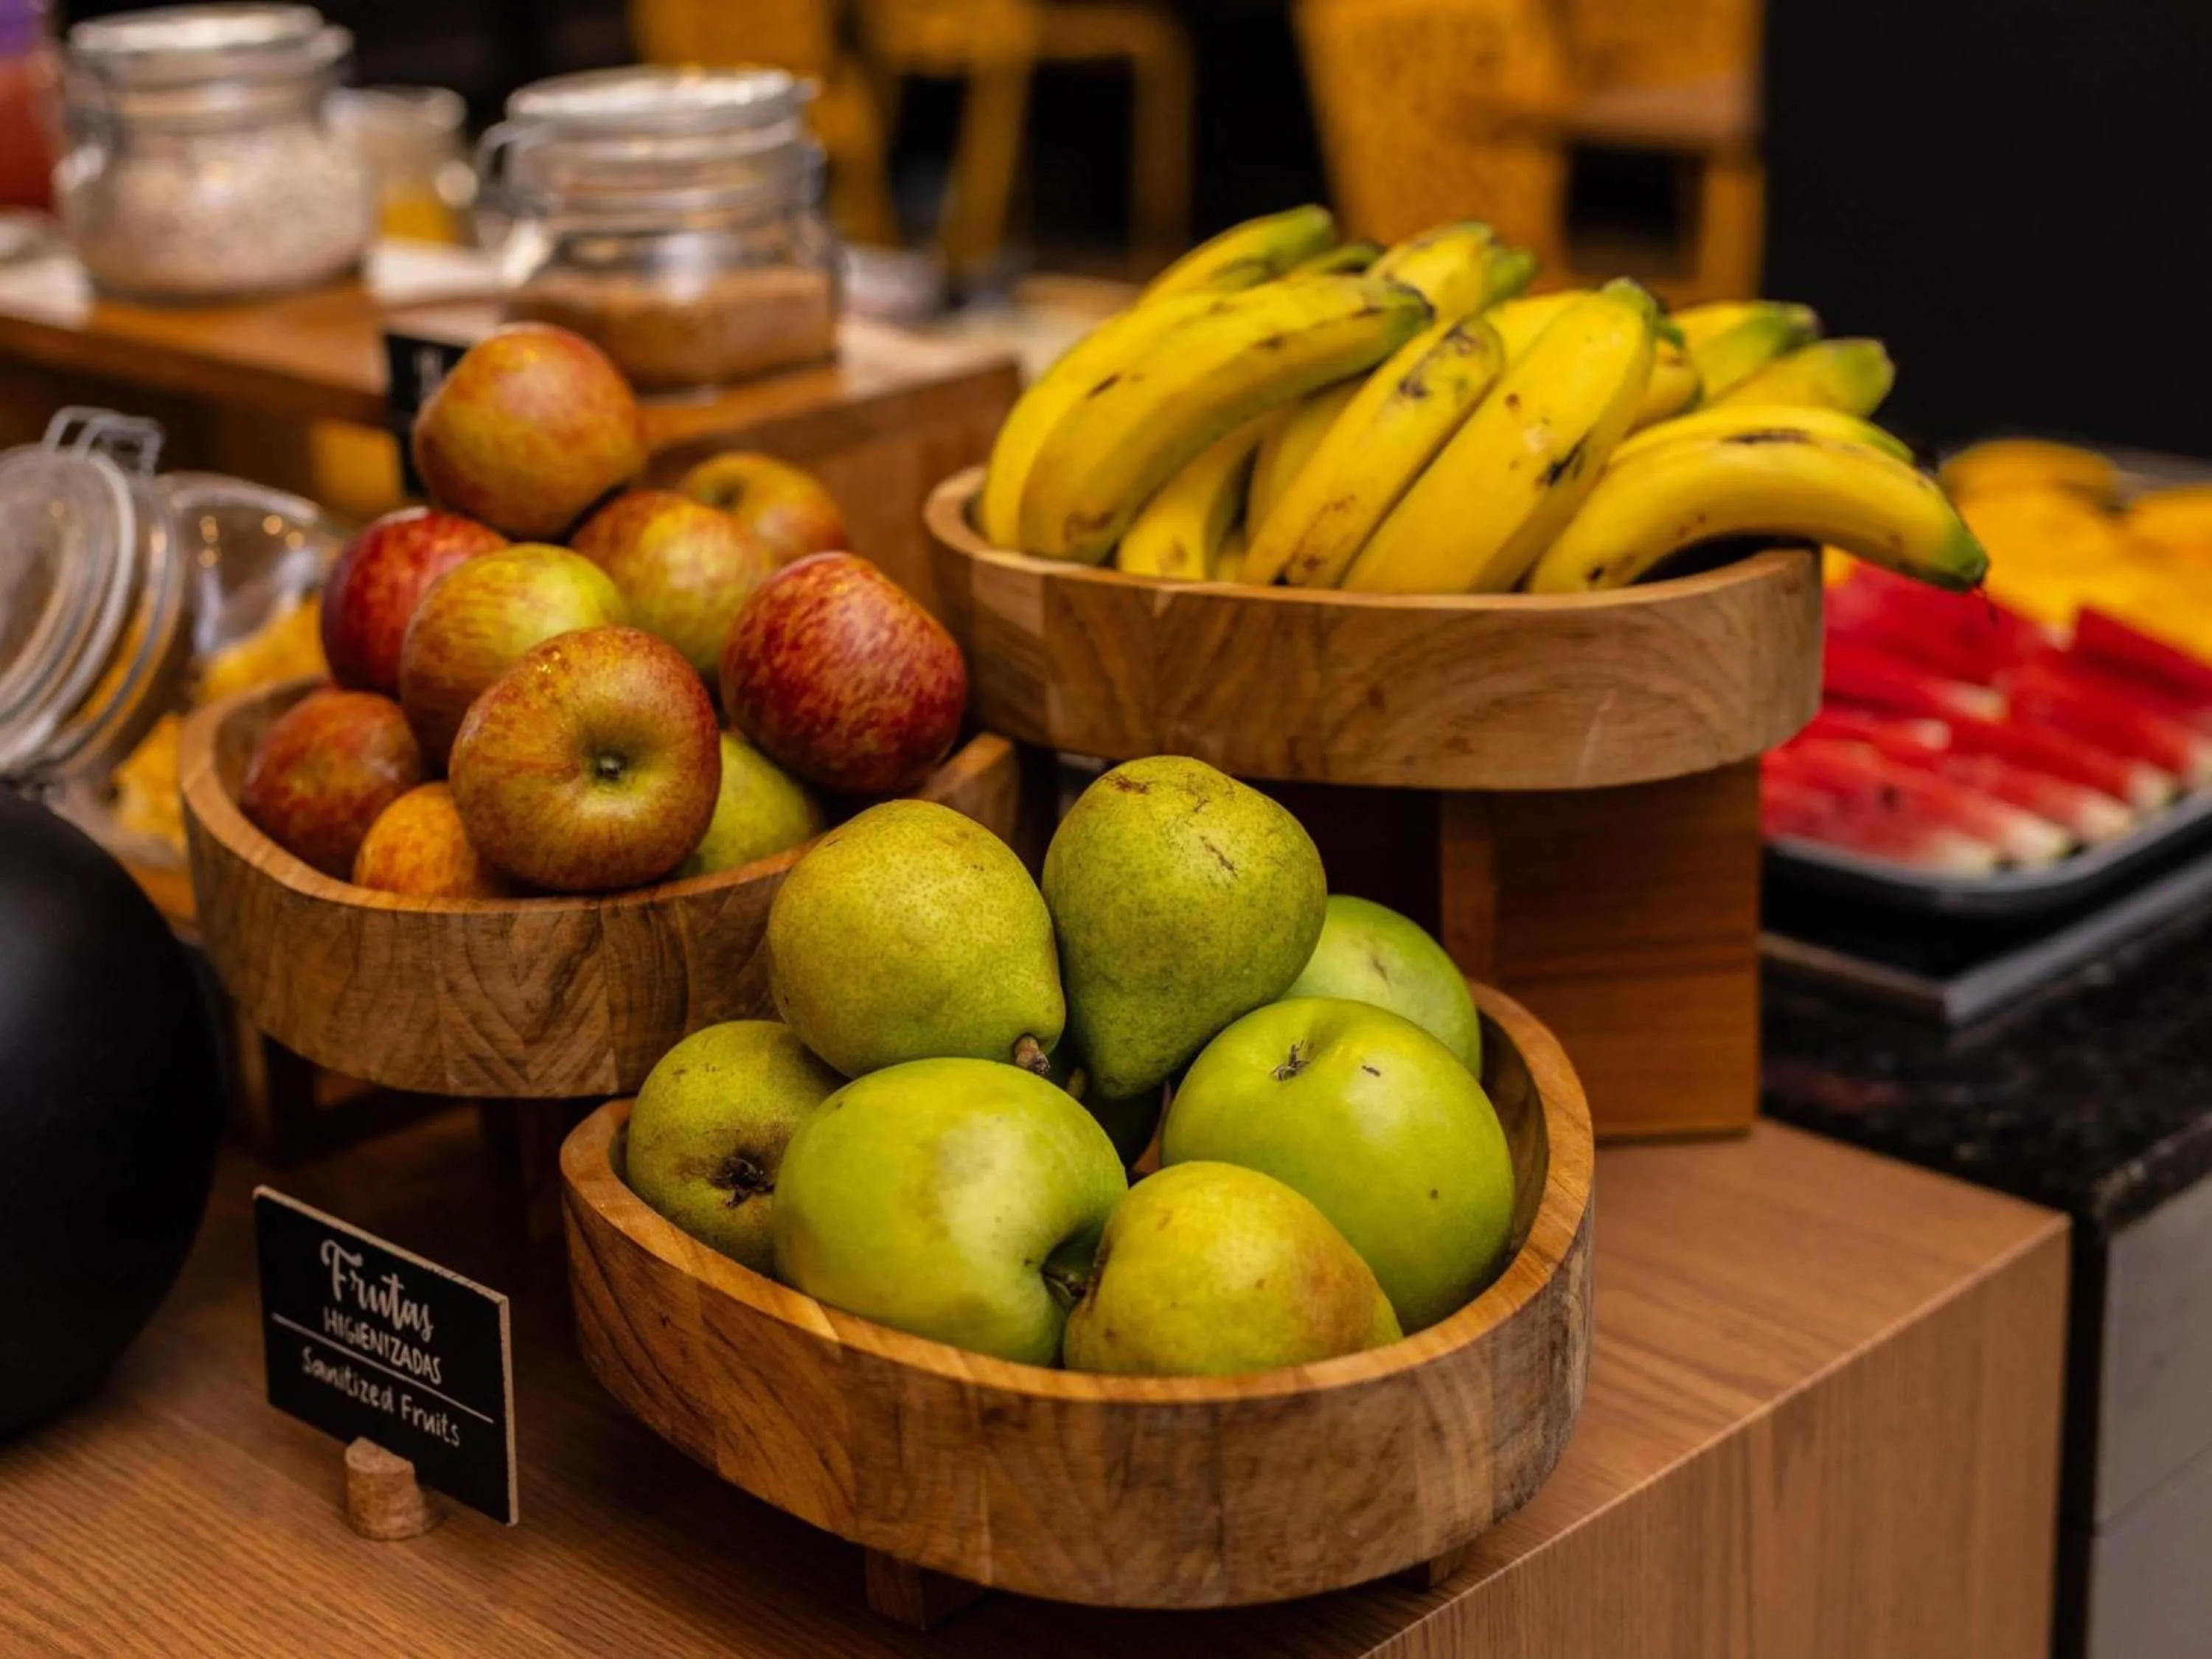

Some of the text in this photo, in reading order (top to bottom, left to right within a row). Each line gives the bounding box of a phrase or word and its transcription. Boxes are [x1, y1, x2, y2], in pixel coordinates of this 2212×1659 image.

[320, 1239, 434, 1342] Frutas
[302, 1346, 460, 1447] Sanitized Fruits
[323, 1307, 442, 1385] HIGIENIZADAS
